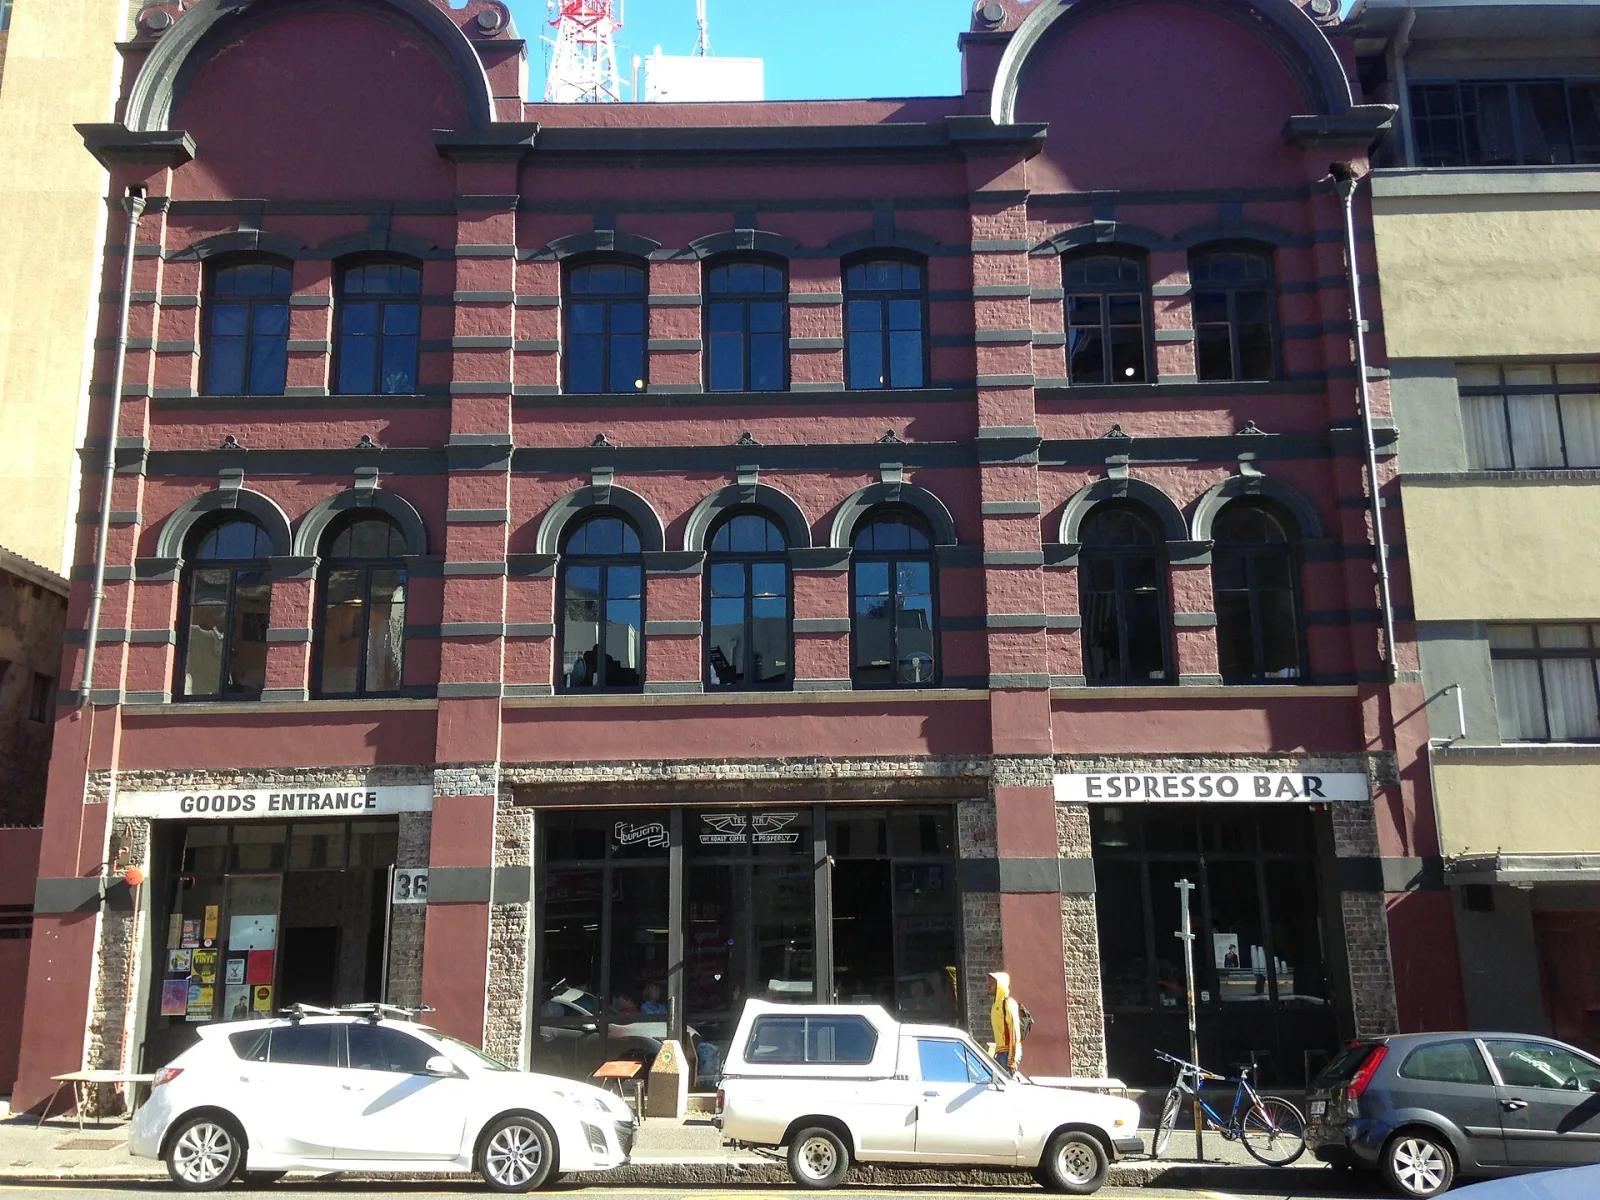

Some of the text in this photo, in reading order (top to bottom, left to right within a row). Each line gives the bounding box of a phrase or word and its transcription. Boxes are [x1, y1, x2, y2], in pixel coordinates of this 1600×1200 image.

[1085, 775, 1327, 798] ESPRESSO BAR
[180, 791, 377, 813] GOODS ENTRANCE
[621, 826, 661, 841] DUPLICITY
[397, 874, 428, 900] 36
[195, 955, 214, 964] VINYL
